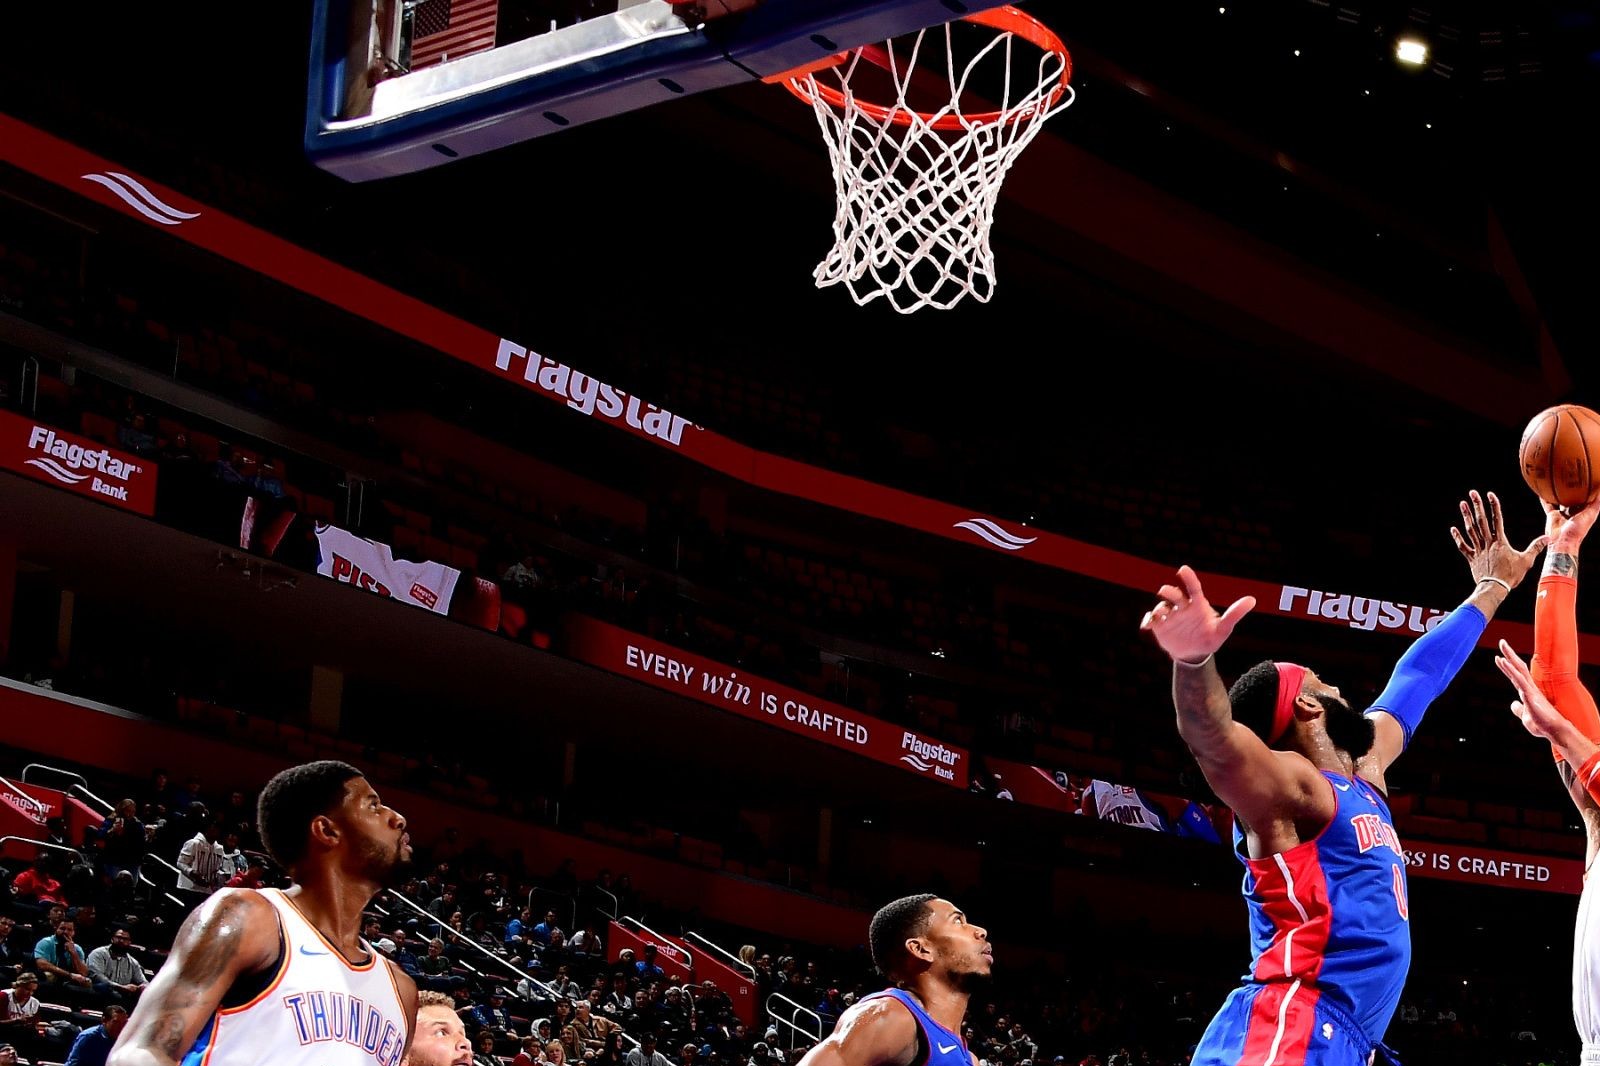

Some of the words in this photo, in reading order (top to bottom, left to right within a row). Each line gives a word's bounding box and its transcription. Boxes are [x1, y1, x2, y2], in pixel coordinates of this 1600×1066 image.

[28, 426, 135, 481] Flagstar
[91, 477, 128, 501] Bank
[1279, 585, 1451, 631] Flagst
[626, 645, 694, 685] EVERY
[702, 672, 752, 705] win
[760, 691, 777, 715] IS
[784, 701, 868, 745] CRAFTED
[901, 732, 958, 766] Flagstar
[935, 765, 954, 780] Bank
[1432, 853, 1450, 870] IS
[1457, 857, 1550, 882] CRAFTED
